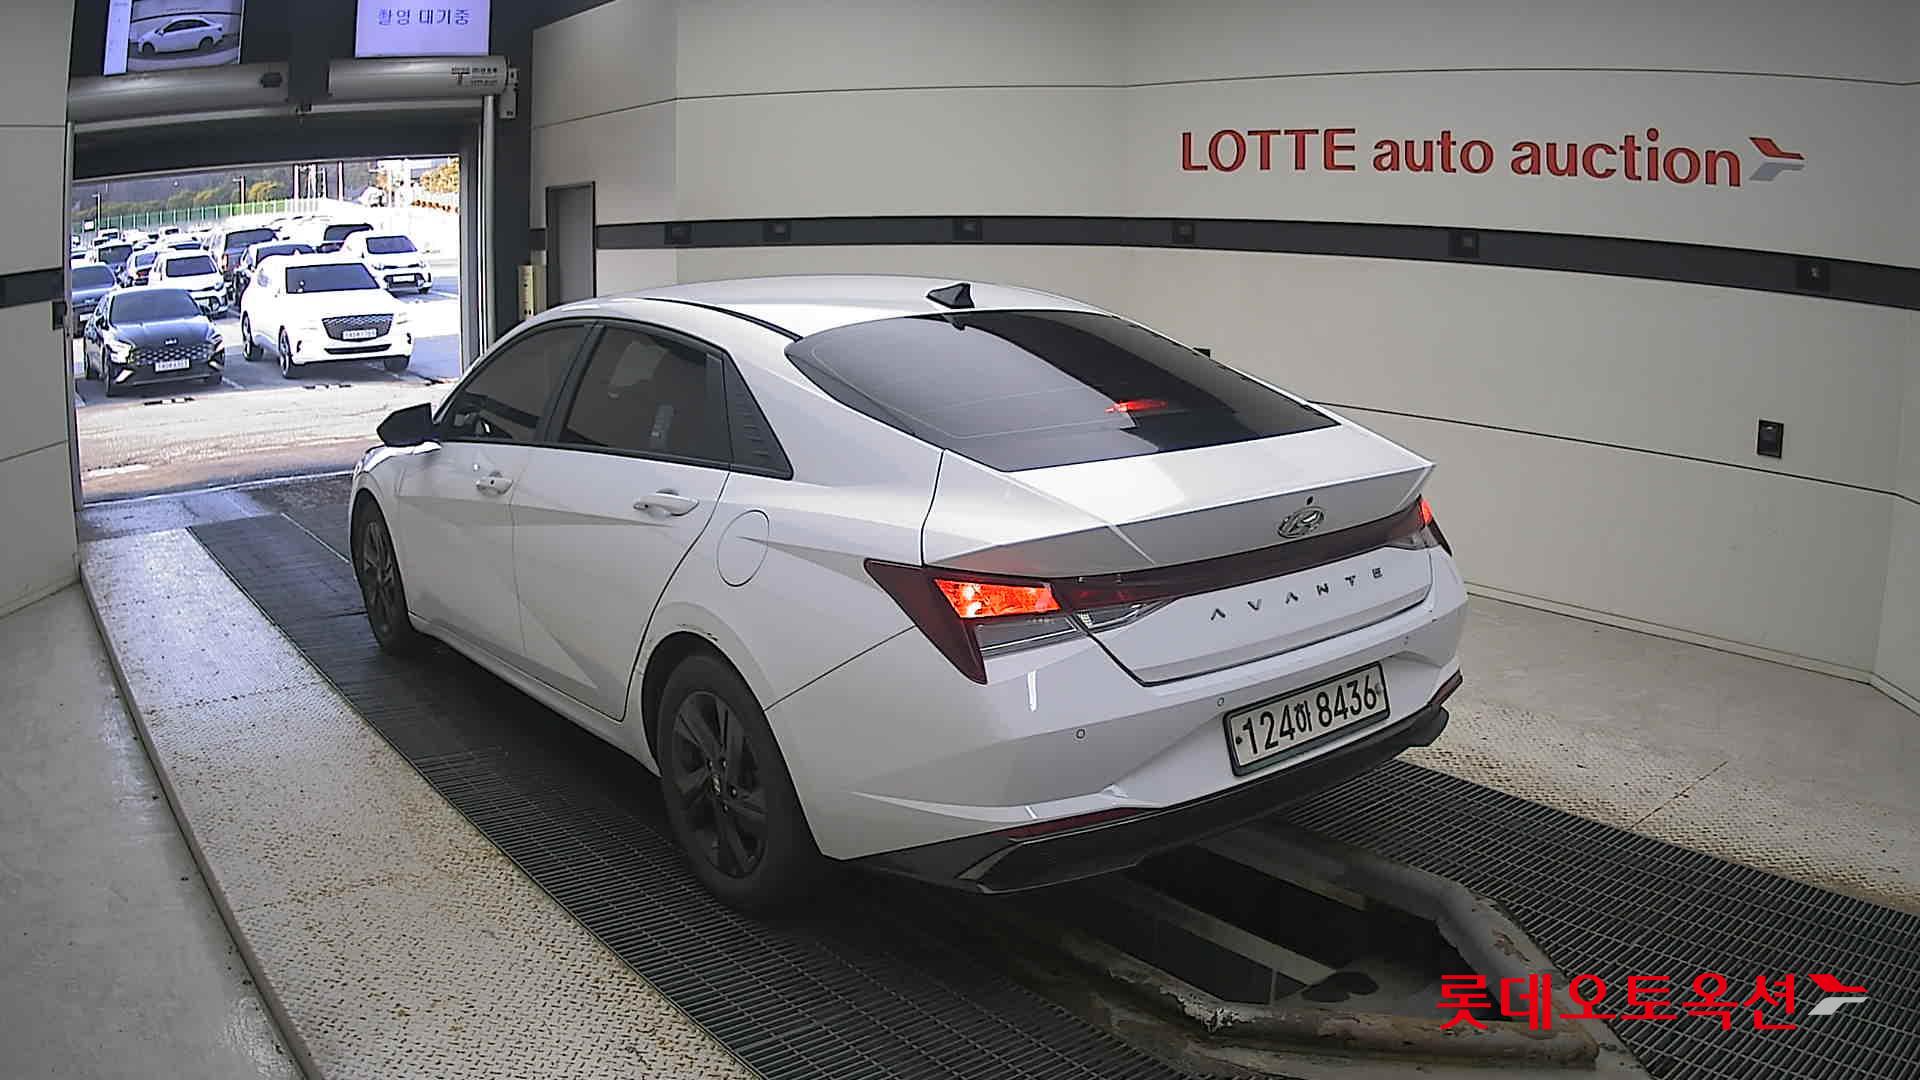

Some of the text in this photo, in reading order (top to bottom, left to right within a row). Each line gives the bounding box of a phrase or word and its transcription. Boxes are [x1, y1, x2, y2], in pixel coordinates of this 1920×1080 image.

[418, 8, 471, 26] 대기중
[1180, 127, 1742, 188] LOTTE auto auction
[1210, 567, 1384, 621] AVANTE
